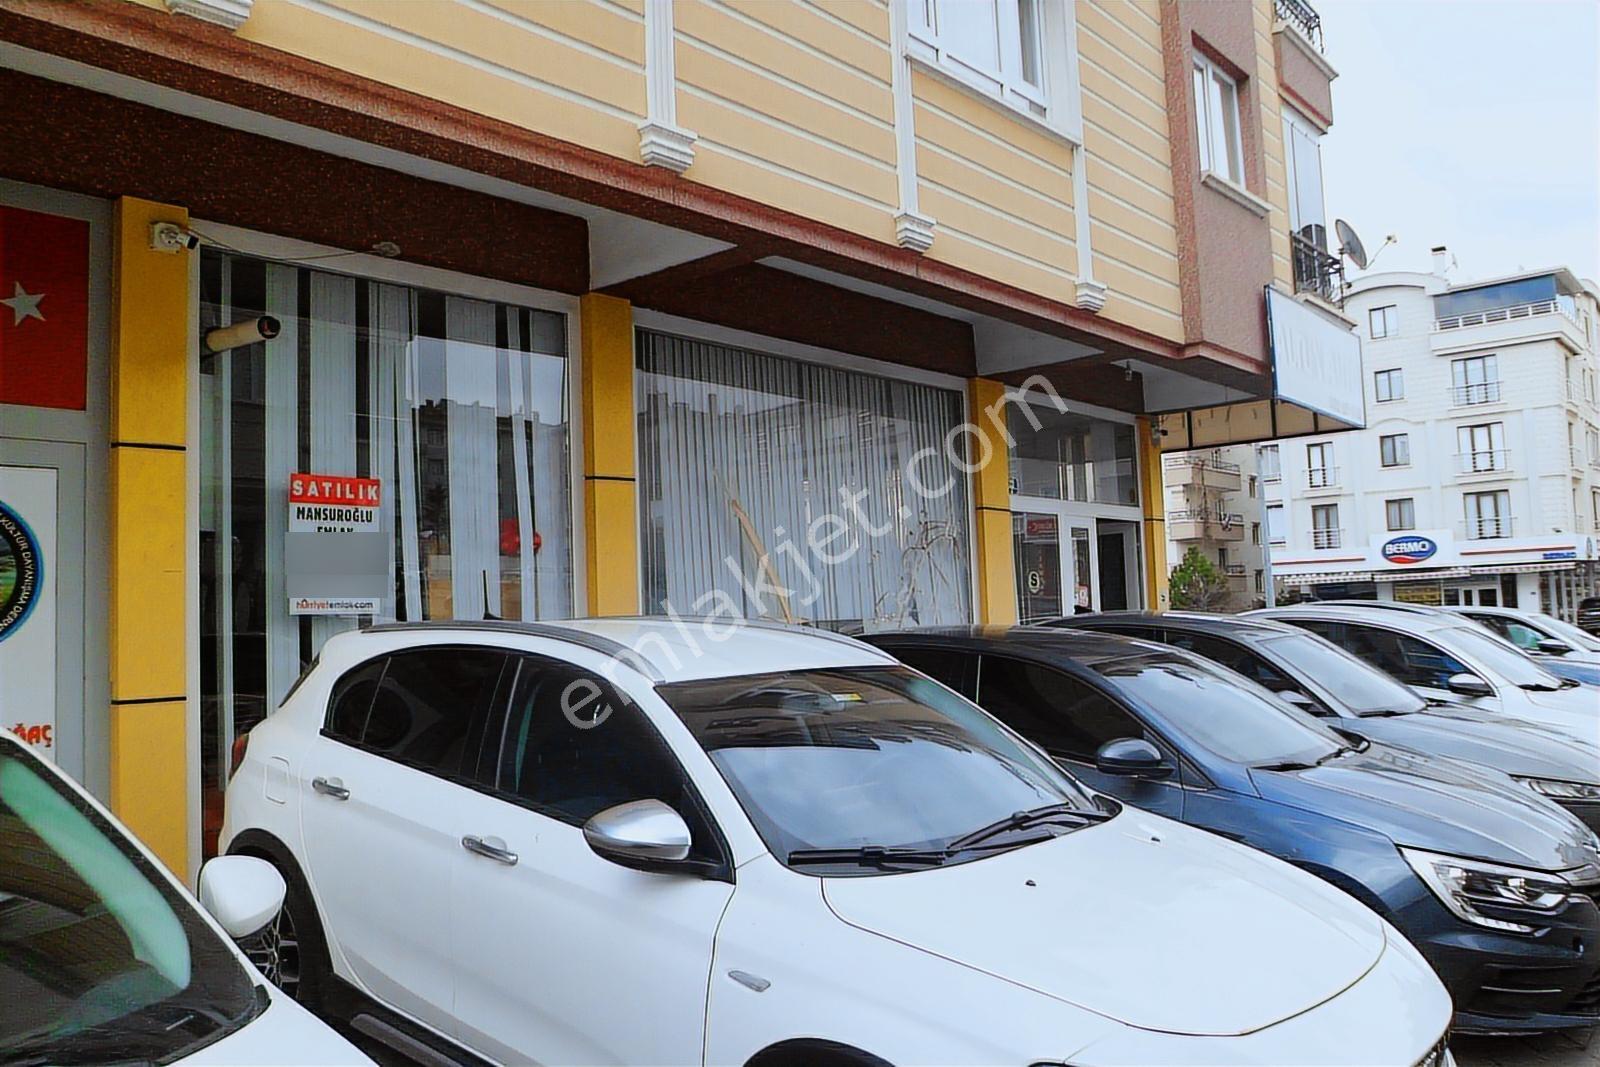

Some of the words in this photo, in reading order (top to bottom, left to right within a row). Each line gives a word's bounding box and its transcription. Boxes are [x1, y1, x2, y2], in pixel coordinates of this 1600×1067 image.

[292, 480, 379, 500] SATILIK
[296, 506, 373, 523] MANSUROĞLU
[1385, 540, 1429, 555] BERMO
